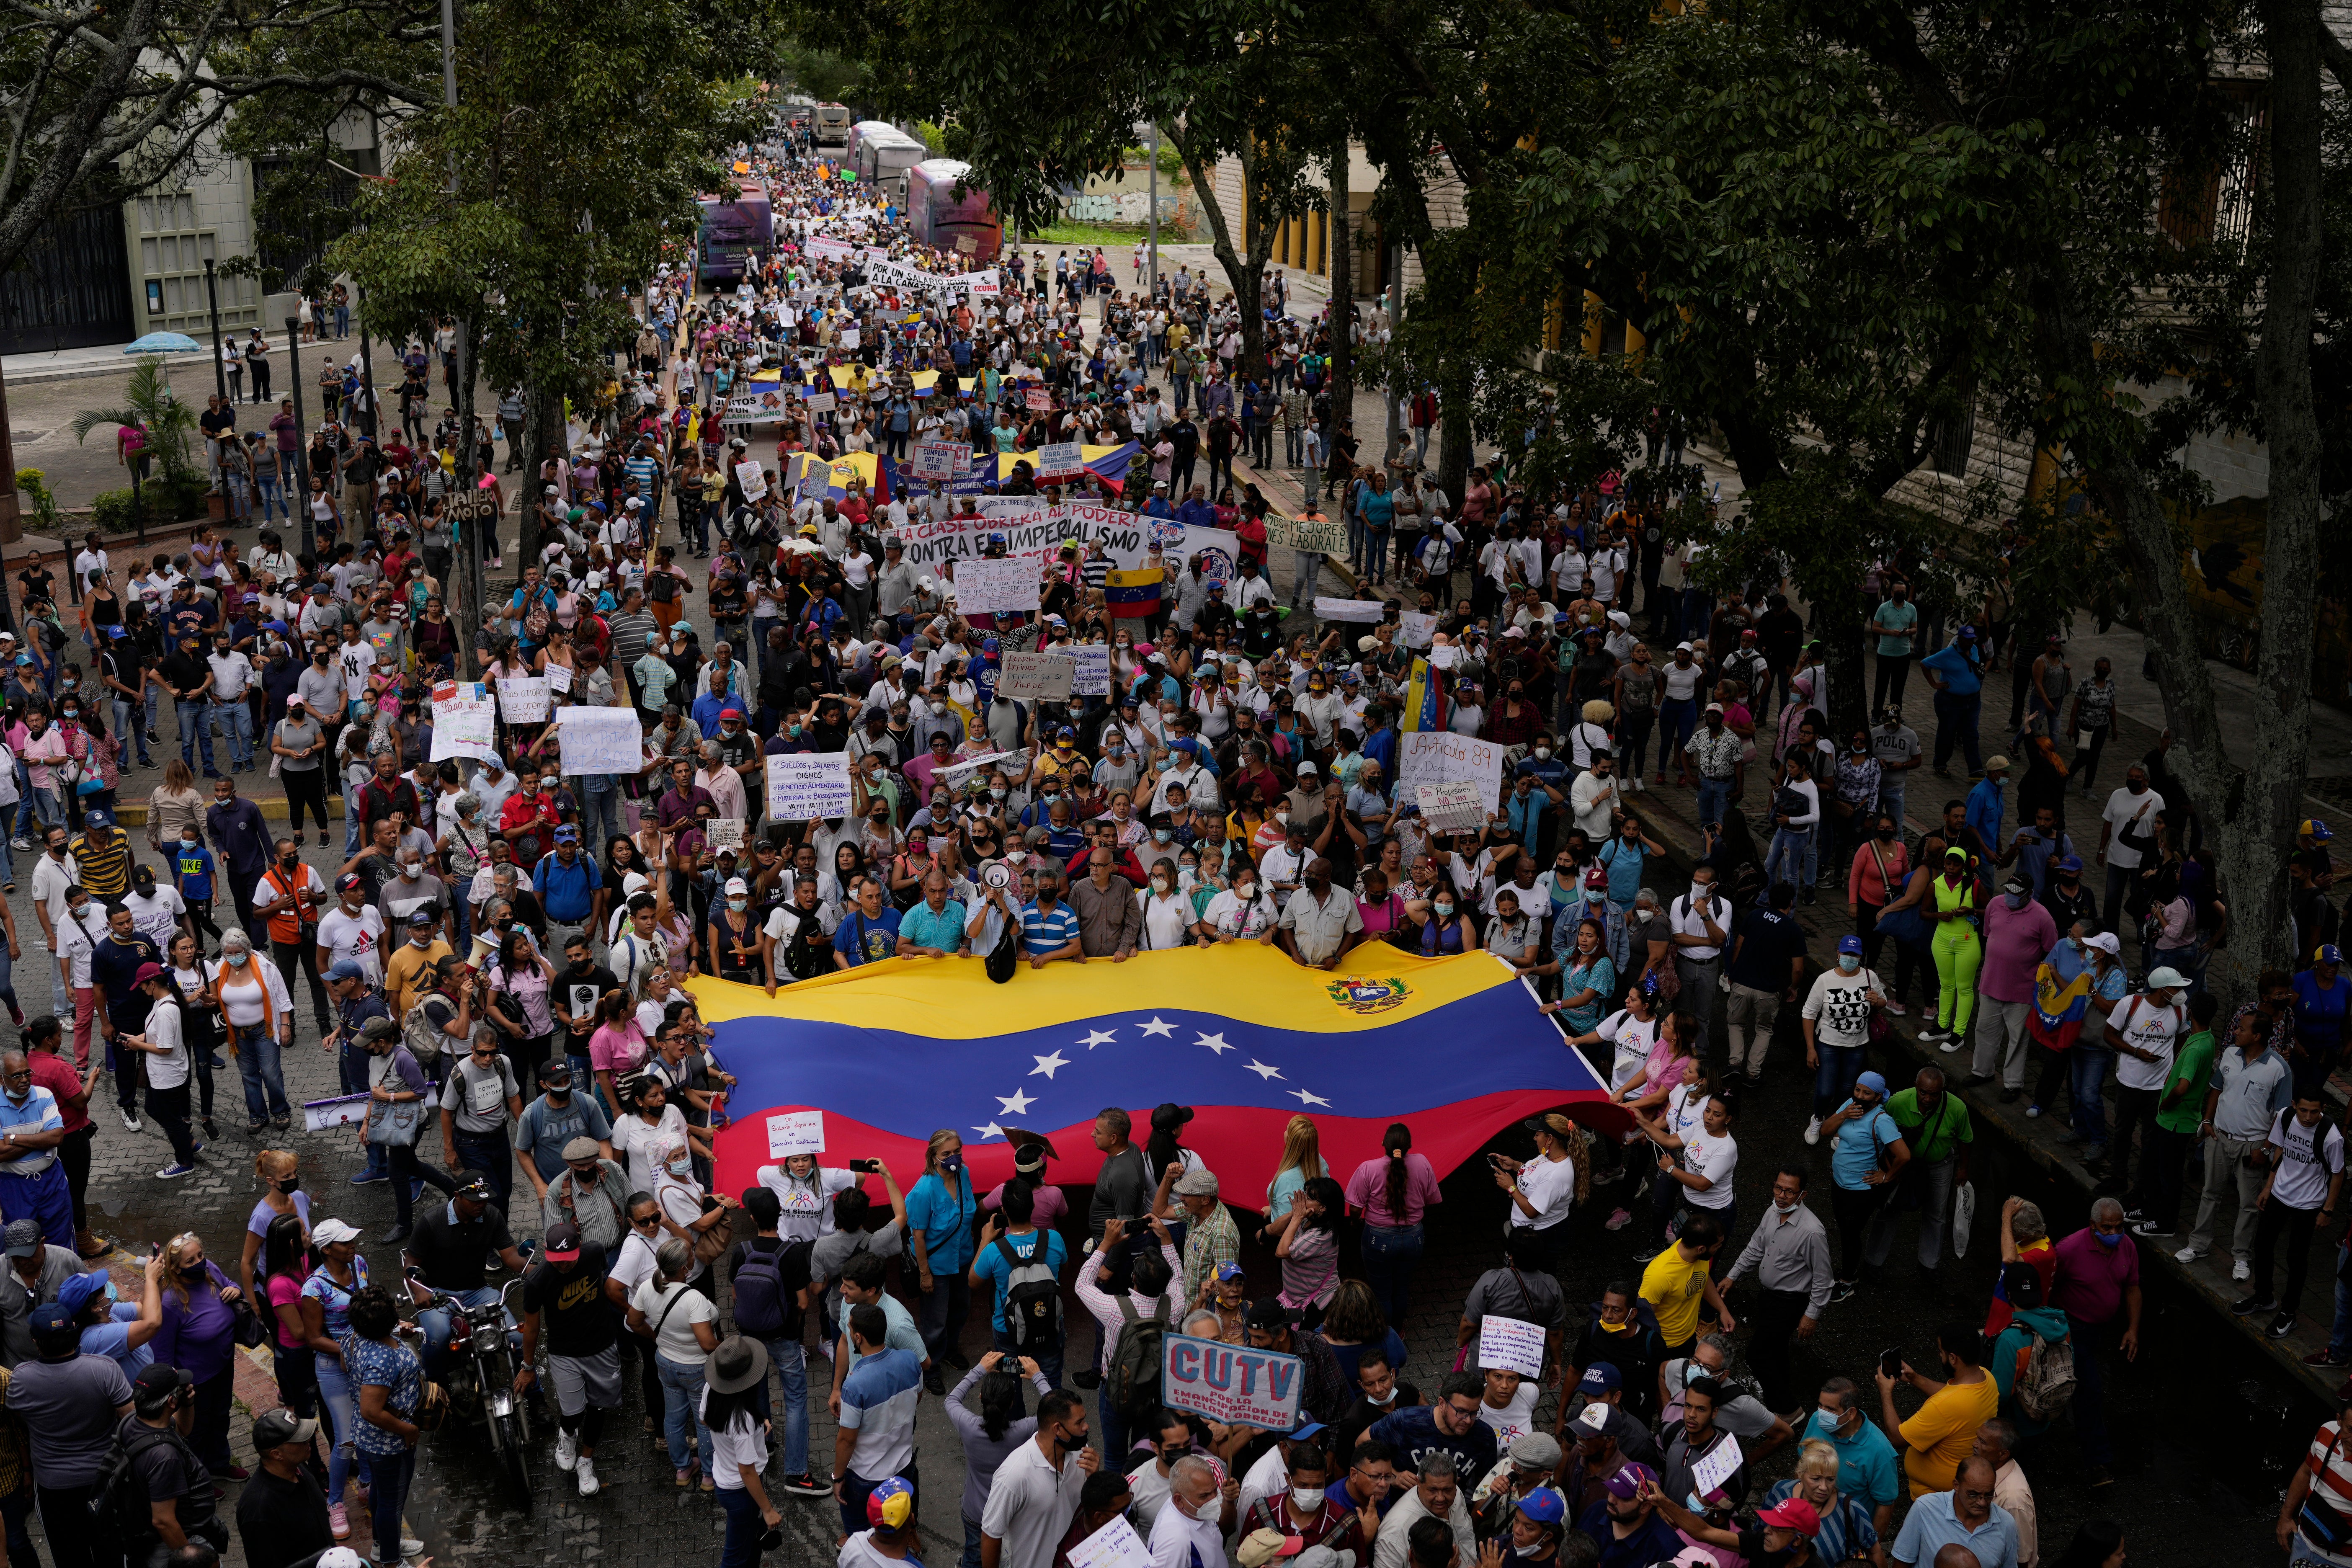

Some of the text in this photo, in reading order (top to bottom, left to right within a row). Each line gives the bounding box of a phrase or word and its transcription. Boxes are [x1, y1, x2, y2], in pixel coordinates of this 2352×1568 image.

[873, 263, 887, 273] POR
[892, 269, 903, 279] UN
[906, 273, 943, 285] SALARIO
[872, 273, 937, 289] A LA CANASTA
[715, 397, 756, 406] JUNTOS
[1040, 455, 1082, 464] TRABAJADORES
[917, 470, 947, 478] FNLCT-CUTV
[1046, 468, 1079, 476] CUTV-FNLCT
[446, 503, 492, 523] MOTO
[918, 505, 1139, 539] CLASE OBRERA AL PODER!
[1290, 521, 1345, 536] MEJORES
[1007, 518, 1140, 553] IMPERIALISMO
[1156, 524, 1178, 536] FSM
[1290, 532, 1350, 553] LABORALES
[961, 560, 989, 570] Mientras
[176, 611, 203, 622] HOUSTON
[1049, 656, 1064, 664] NO
[1010, 680, 1044, 689] PIERDE
[441, 700, 462, 714] Pago
[524, 701, 549, 714] gremio
[503, 712, 535, 722] Docente
[443, 723, 474, 734] Derechos
[598, 730, 636, 743] Patria
[1875, 735, 1907, 749] POLO
[592, 748, 612, 768] 13
[1411, 735, 1490, 769] Articulo 89
[1405, 759, 1496, 785] Los Derechos Laborales
[1421, 787, 1470, 797] Sin Profesores
[1438, 797, 1449, 805] NO
[821, 807, 845, 816] LUCHA
[180, 859, 202, 873] NIKE
[136, 915, 155, 924] FIELD
[1763, 911, 1781, 924] UCV
[880, 931, 894, 943] CENTRAL
[350, 941, 377, 956] adidas
[1625, 1045, 1648, 1057] Sindical
[478, 1082, 498, 1092] TOMMY
[477, 1088, 501, 1100] HILFIGER
[542, 1117, 585, 1137] AIR
[562, 1275, 589, 1299] NIKE
[584, 1287, 598, 1302] SB
[1171, 1342, 1296, 1402] CUTV
[1173, 1388, 1288, 1418] EMANCIPACION DE
[1210, 1390, 1233, 1404] POR
[1175, 1397, 1286, 1425] LA CLASE OBRERA
